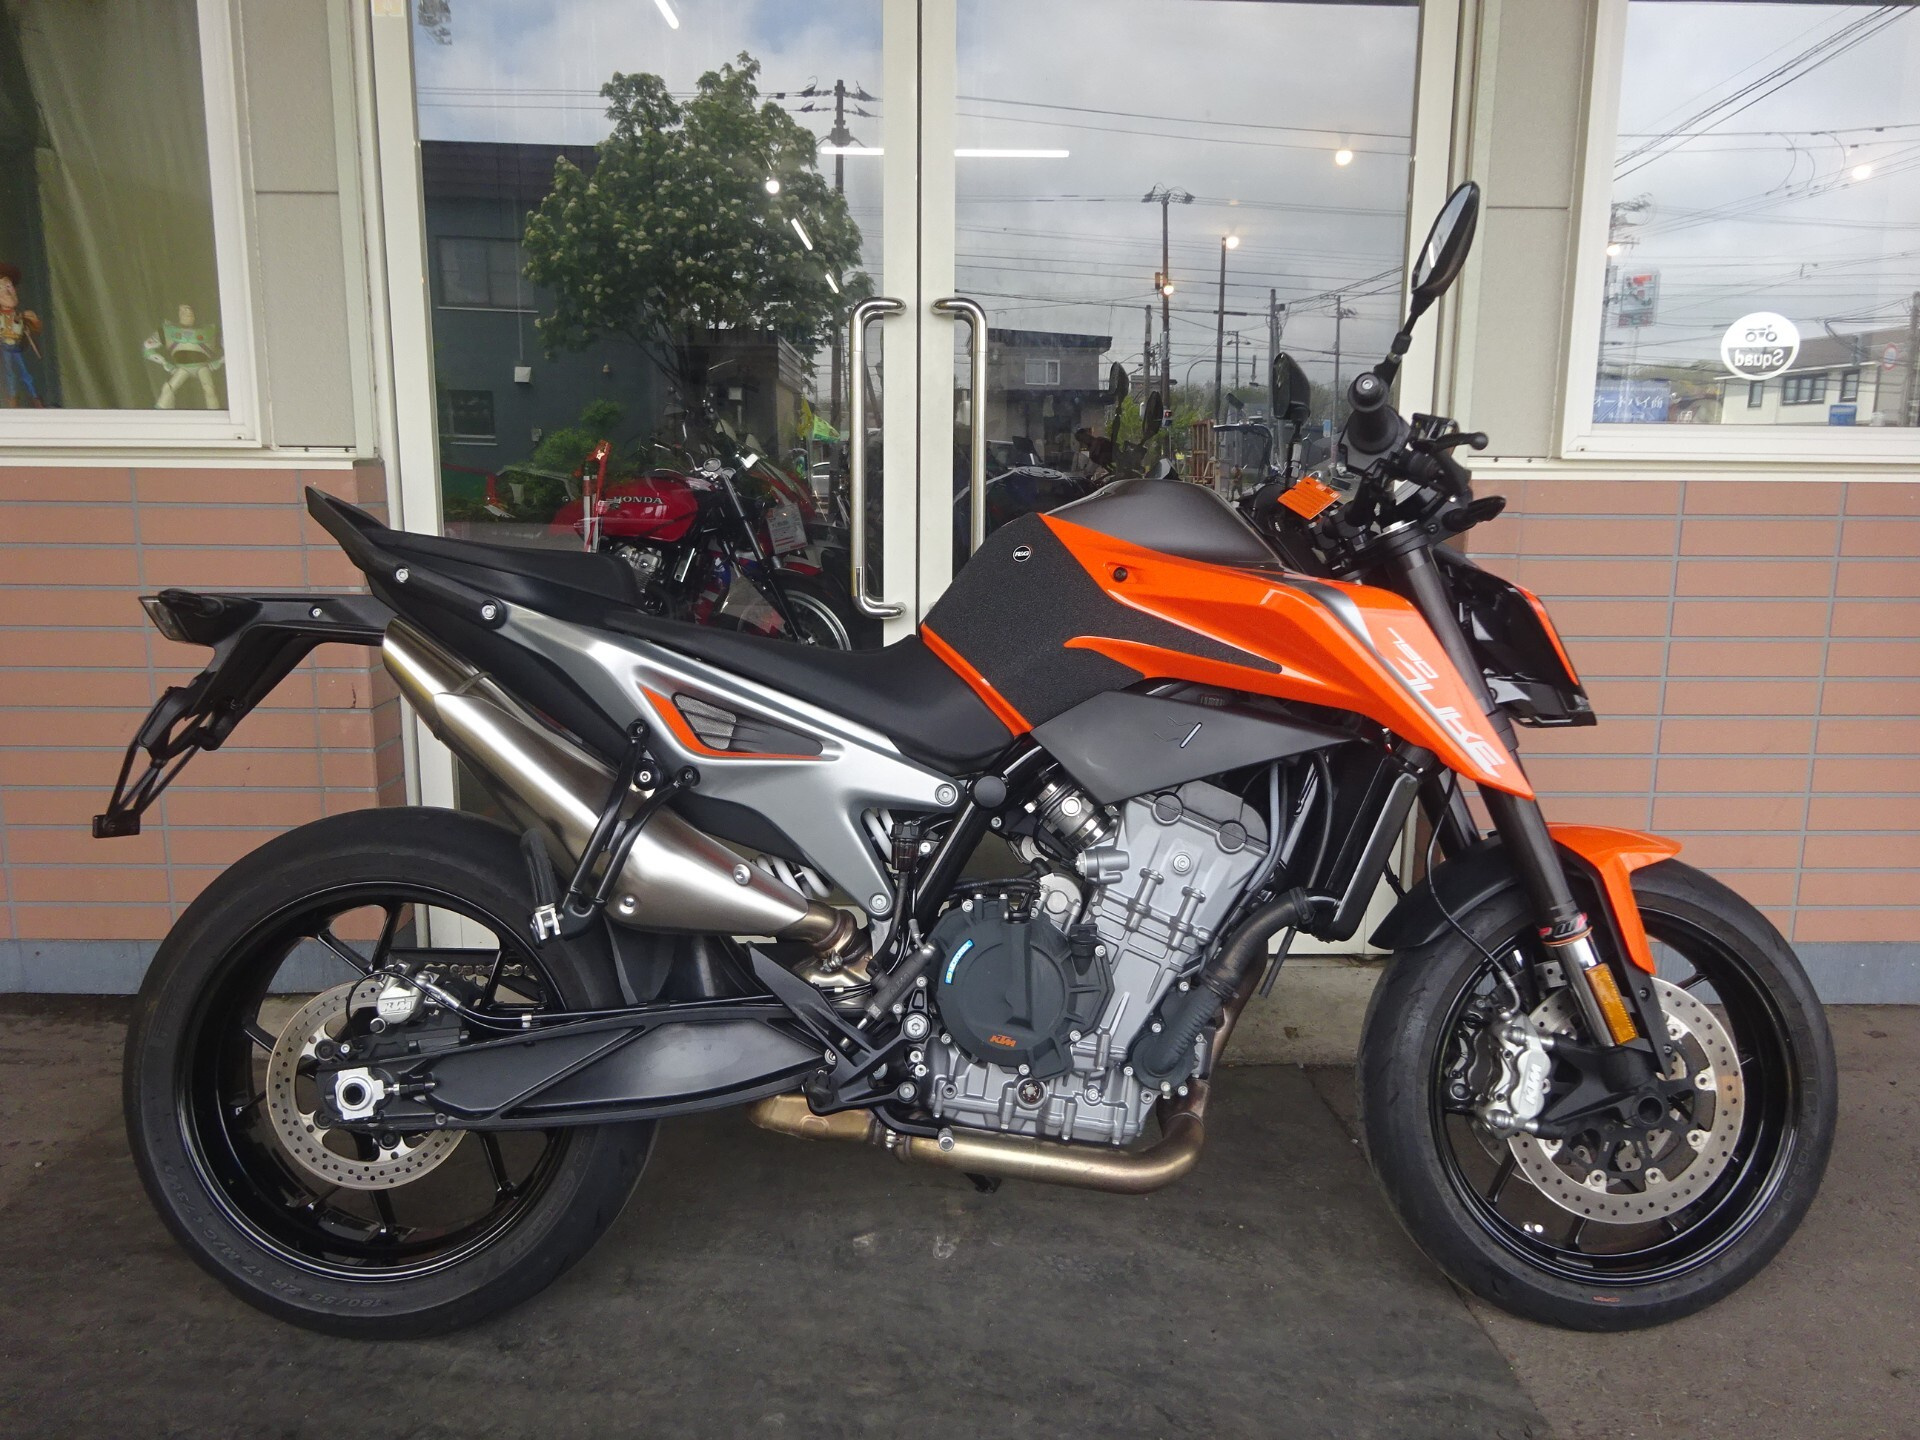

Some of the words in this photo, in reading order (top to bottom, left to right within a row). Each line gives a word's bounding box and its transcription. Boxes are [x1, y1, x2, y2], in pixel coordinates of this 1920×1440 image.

[613, 495, 663, 505] HONDA
[1396, 658, 1507, 778] DUKE
[989, 1034, 1017, 1048] KTM
[1525, 1063, 1542, 1105] KTM
